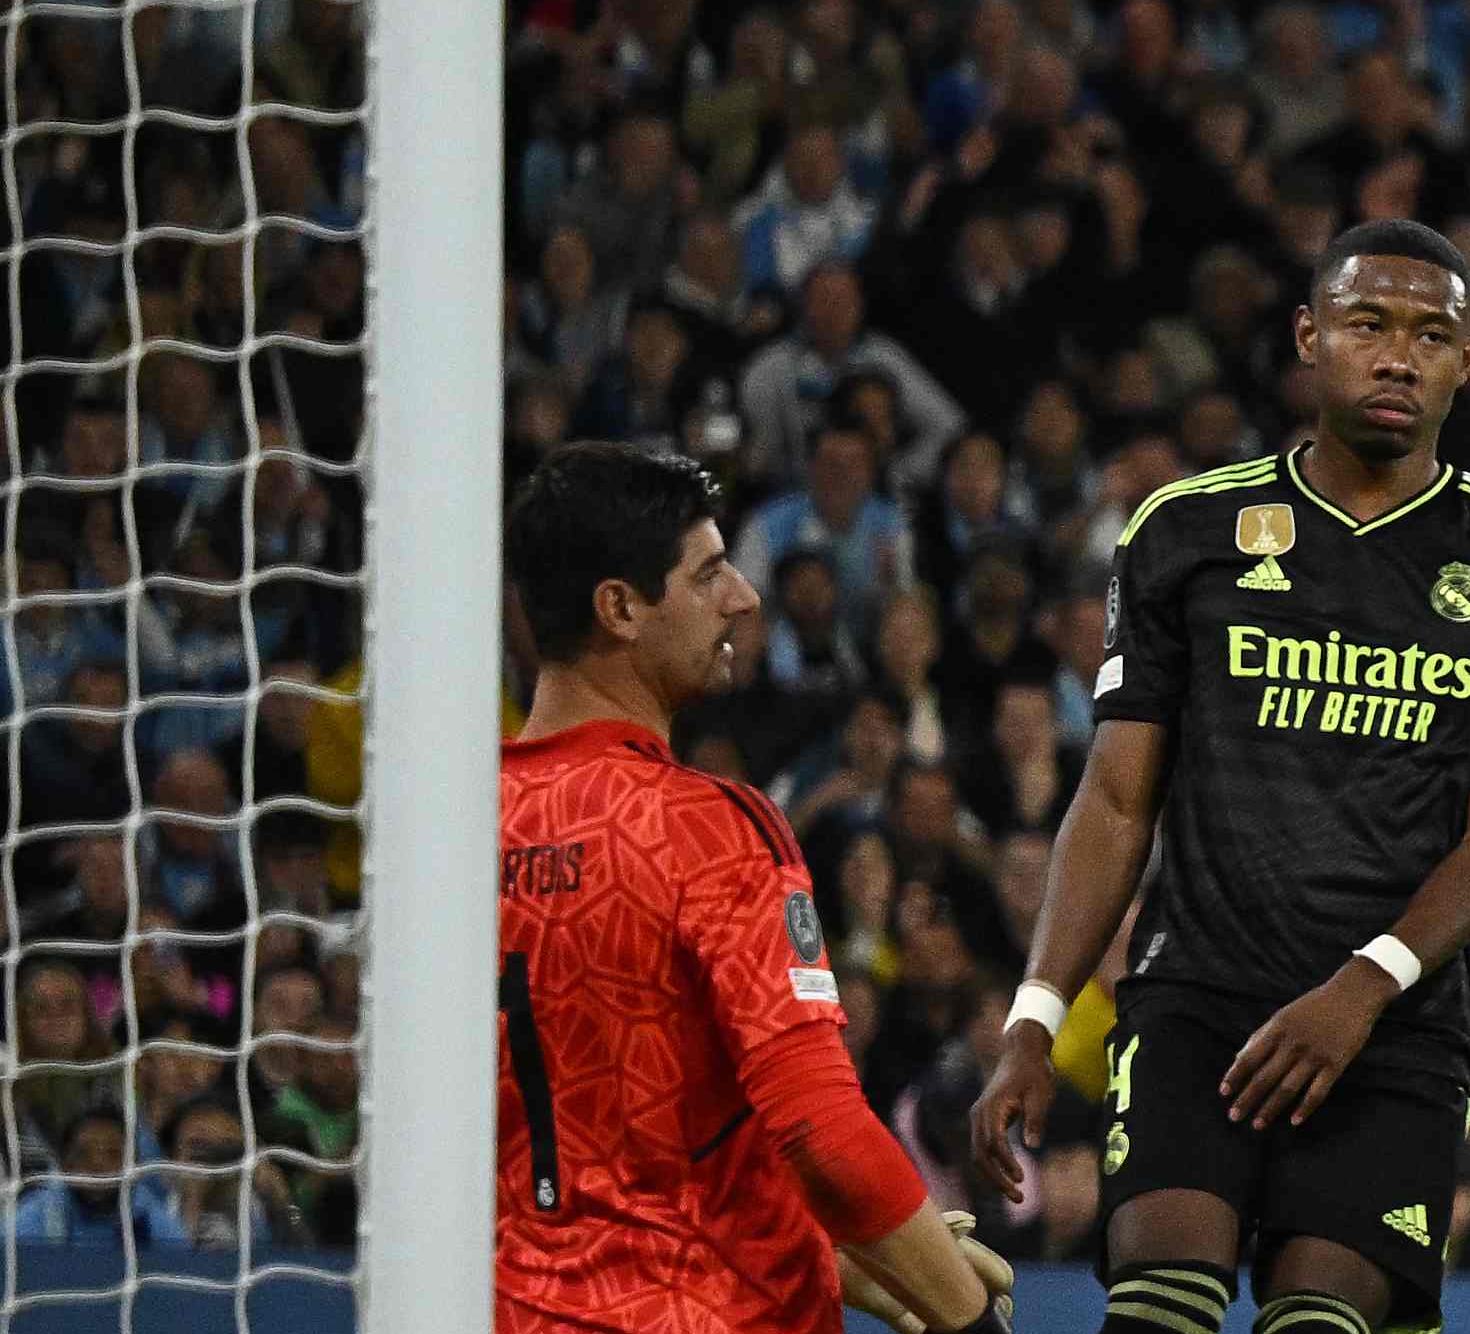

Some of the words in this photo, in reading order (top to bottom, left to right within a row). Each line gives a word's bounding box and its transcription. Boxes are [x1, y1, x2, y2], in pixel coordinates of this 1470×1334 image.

[1236, 577, 1292, 592] adidas
[1257, 685, 1315, 729] FLY
[1320, 690, 1437, 743] BETTER
[499, 951, 560, 1211] 1
[1381, 1212, 1431, 1246] adidas
